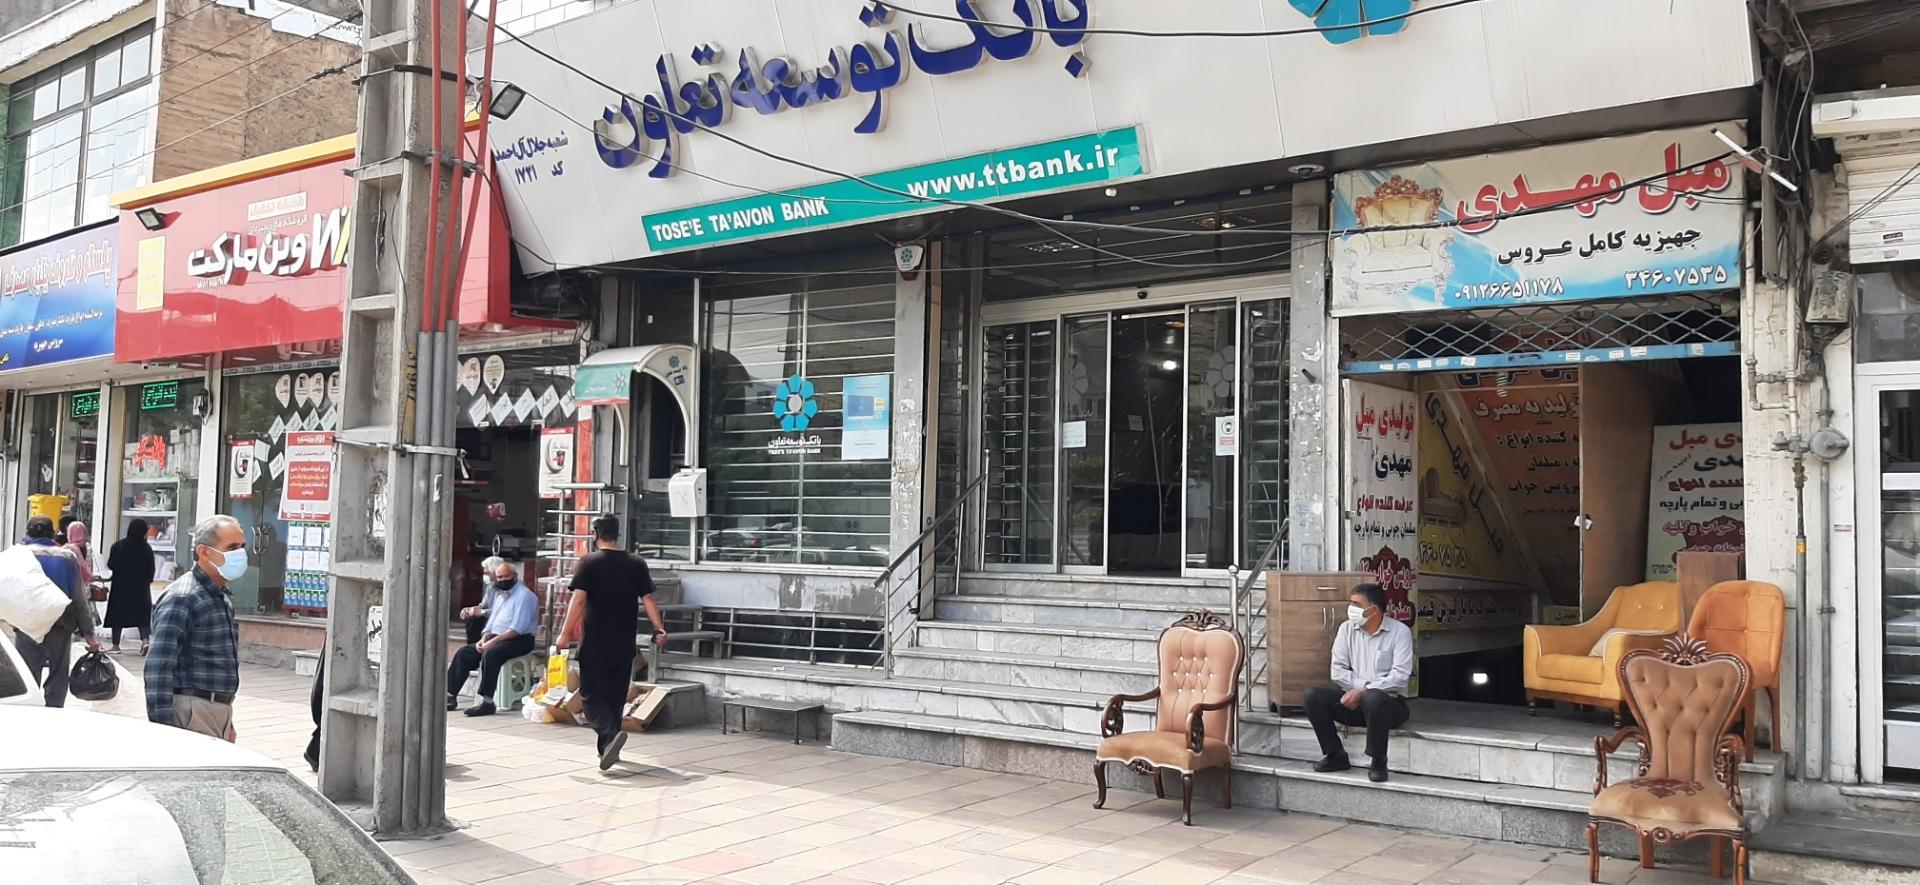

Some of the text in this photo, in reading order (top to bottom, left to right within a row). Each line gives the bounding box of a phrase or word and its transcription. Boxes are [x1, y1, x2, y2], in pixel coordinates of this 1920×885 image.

[731, 0, 910, 134] توسعه
[593, 41, 732, 179] تعاون
[495, 143, 517, 161] احمد
[547, 129, 569, 152] شعبه
[551, 160, 563, 176] کد
[907, 142, 1119, 200] www.ttbank.ir
[1455, 142, 1731, 234] مبل مهدی
[652, 196, 829, 243] TOSE'E TA'AVON BANK
[1578, 230, 1626, 259] کامل
[1632, 228, 1702, 254] جهیزیه
[187, 231, 307, 286] وین مارکت
[1453, 276, 1565, 301] ۰۹۱۲۶۶۵۱۱۷۸
[1624, 264, 1729, 291] ۳۴۶۰۷۵۳۵
[1355, 394, 1415, 440] تولیدی مبل
[1473, 398, 1521, 421] مصرف
[1524, 399, 1542, 418] به
[1506, 431, 1534, 448] انواع
[1669, 429, 1709, 451] مبل
[1375, 450, 1413, 480] مهدی
[1668, 477, 1705, 492] انواع
[1659, 496, 1688, 513] پارچه
[1690, 496, 1718, 511] تمام
[1699, 520, 1737, 536] خواب
